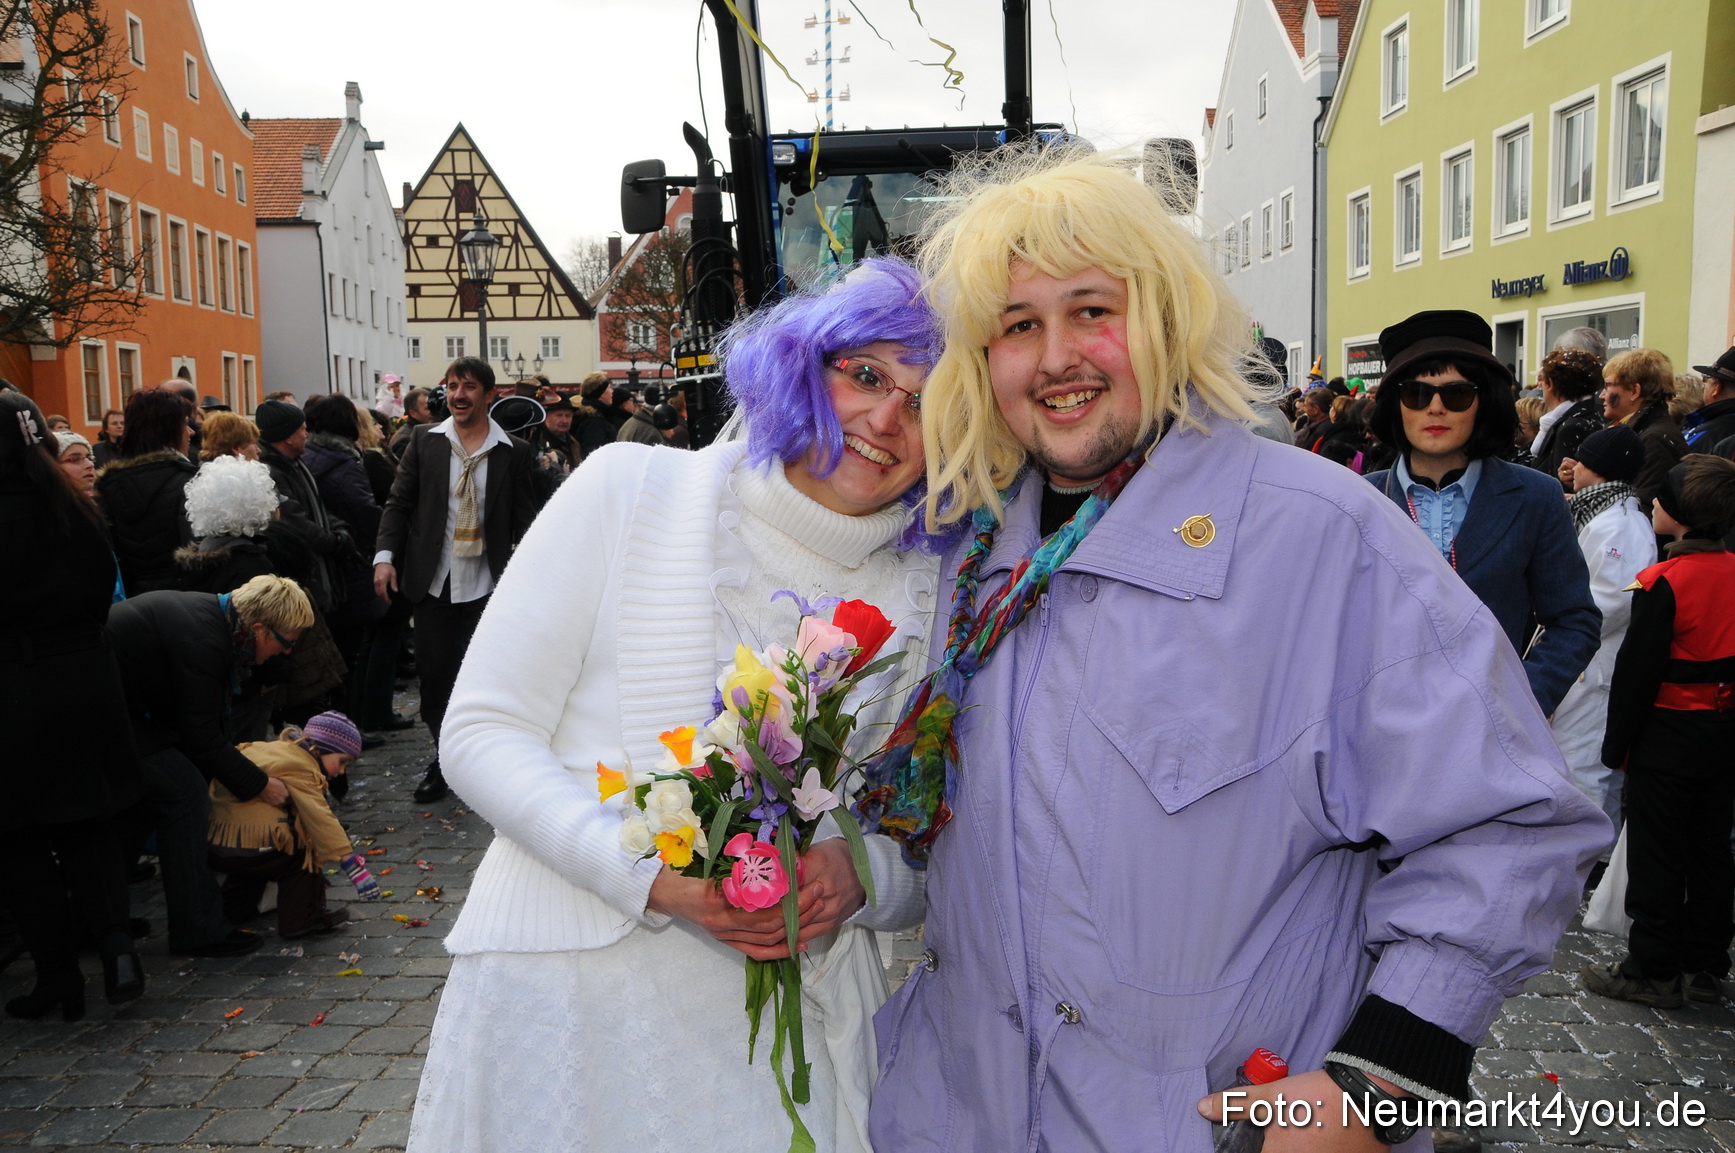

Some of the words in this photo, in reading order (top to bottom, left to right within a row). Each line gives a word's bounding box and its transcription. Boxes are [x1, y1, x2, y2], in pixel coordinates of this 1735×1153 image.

[1491, 274, 1545, 299] Neumeyer
[1563, 260, 1609, 285] Allianz
[1608, 337, 1630, 349] Allianz
[1348, 360, 1381, 376] HOFBAUER
